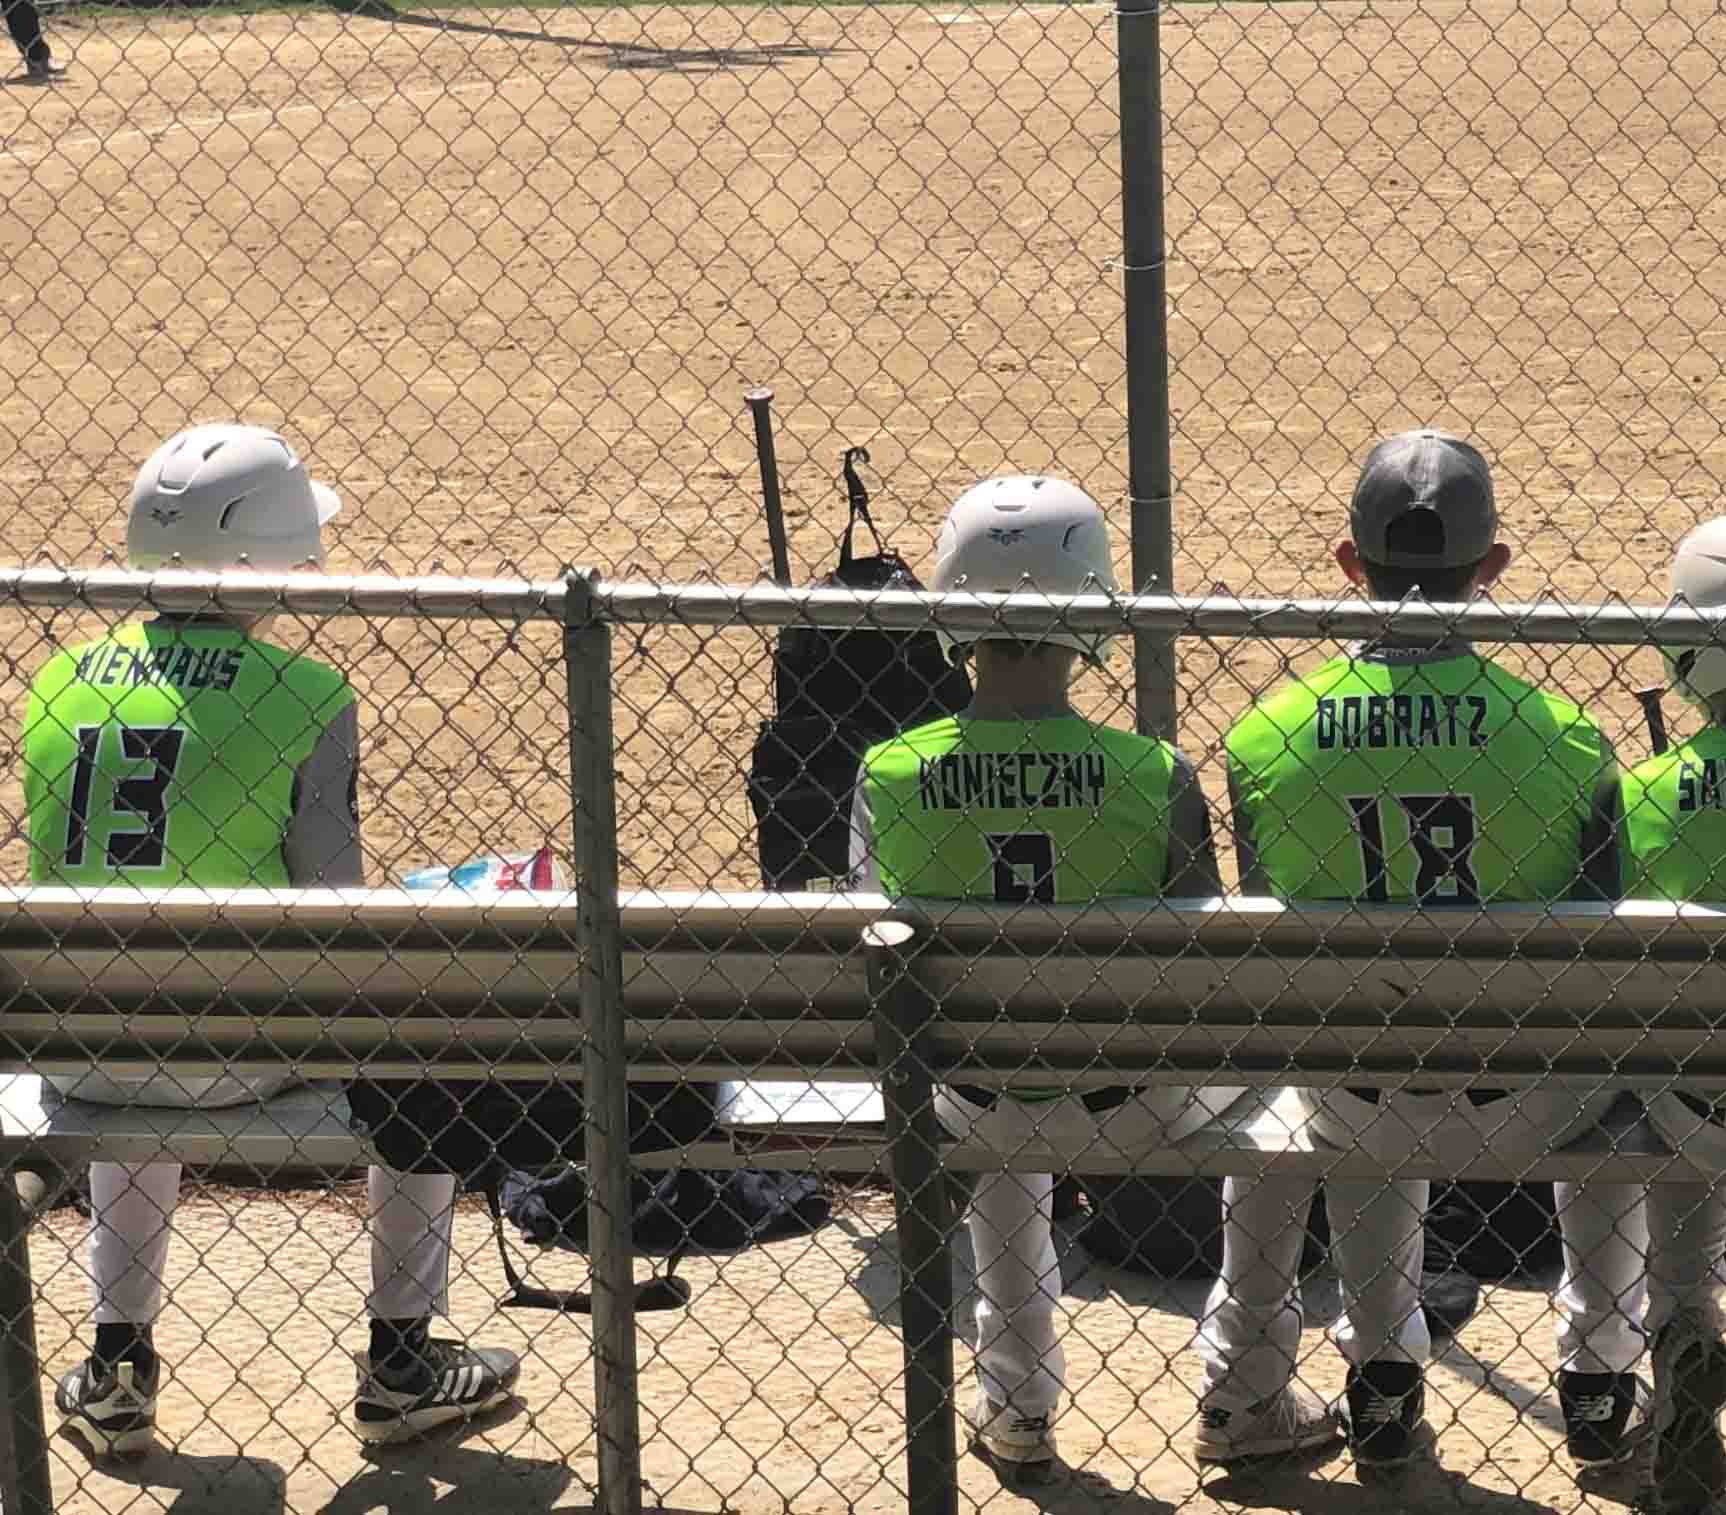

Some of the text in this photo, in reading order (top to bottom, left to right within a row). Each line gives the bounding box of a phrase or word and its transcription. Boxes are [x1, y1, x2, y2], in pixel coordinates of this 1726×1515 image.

[1316, 695, 1489, 750] DOBRATZ
[64, 724, 186, 869] 13
[919, 753, 1106, 809] KONIECZNY
[1346, 794, 1480, 901] 18
